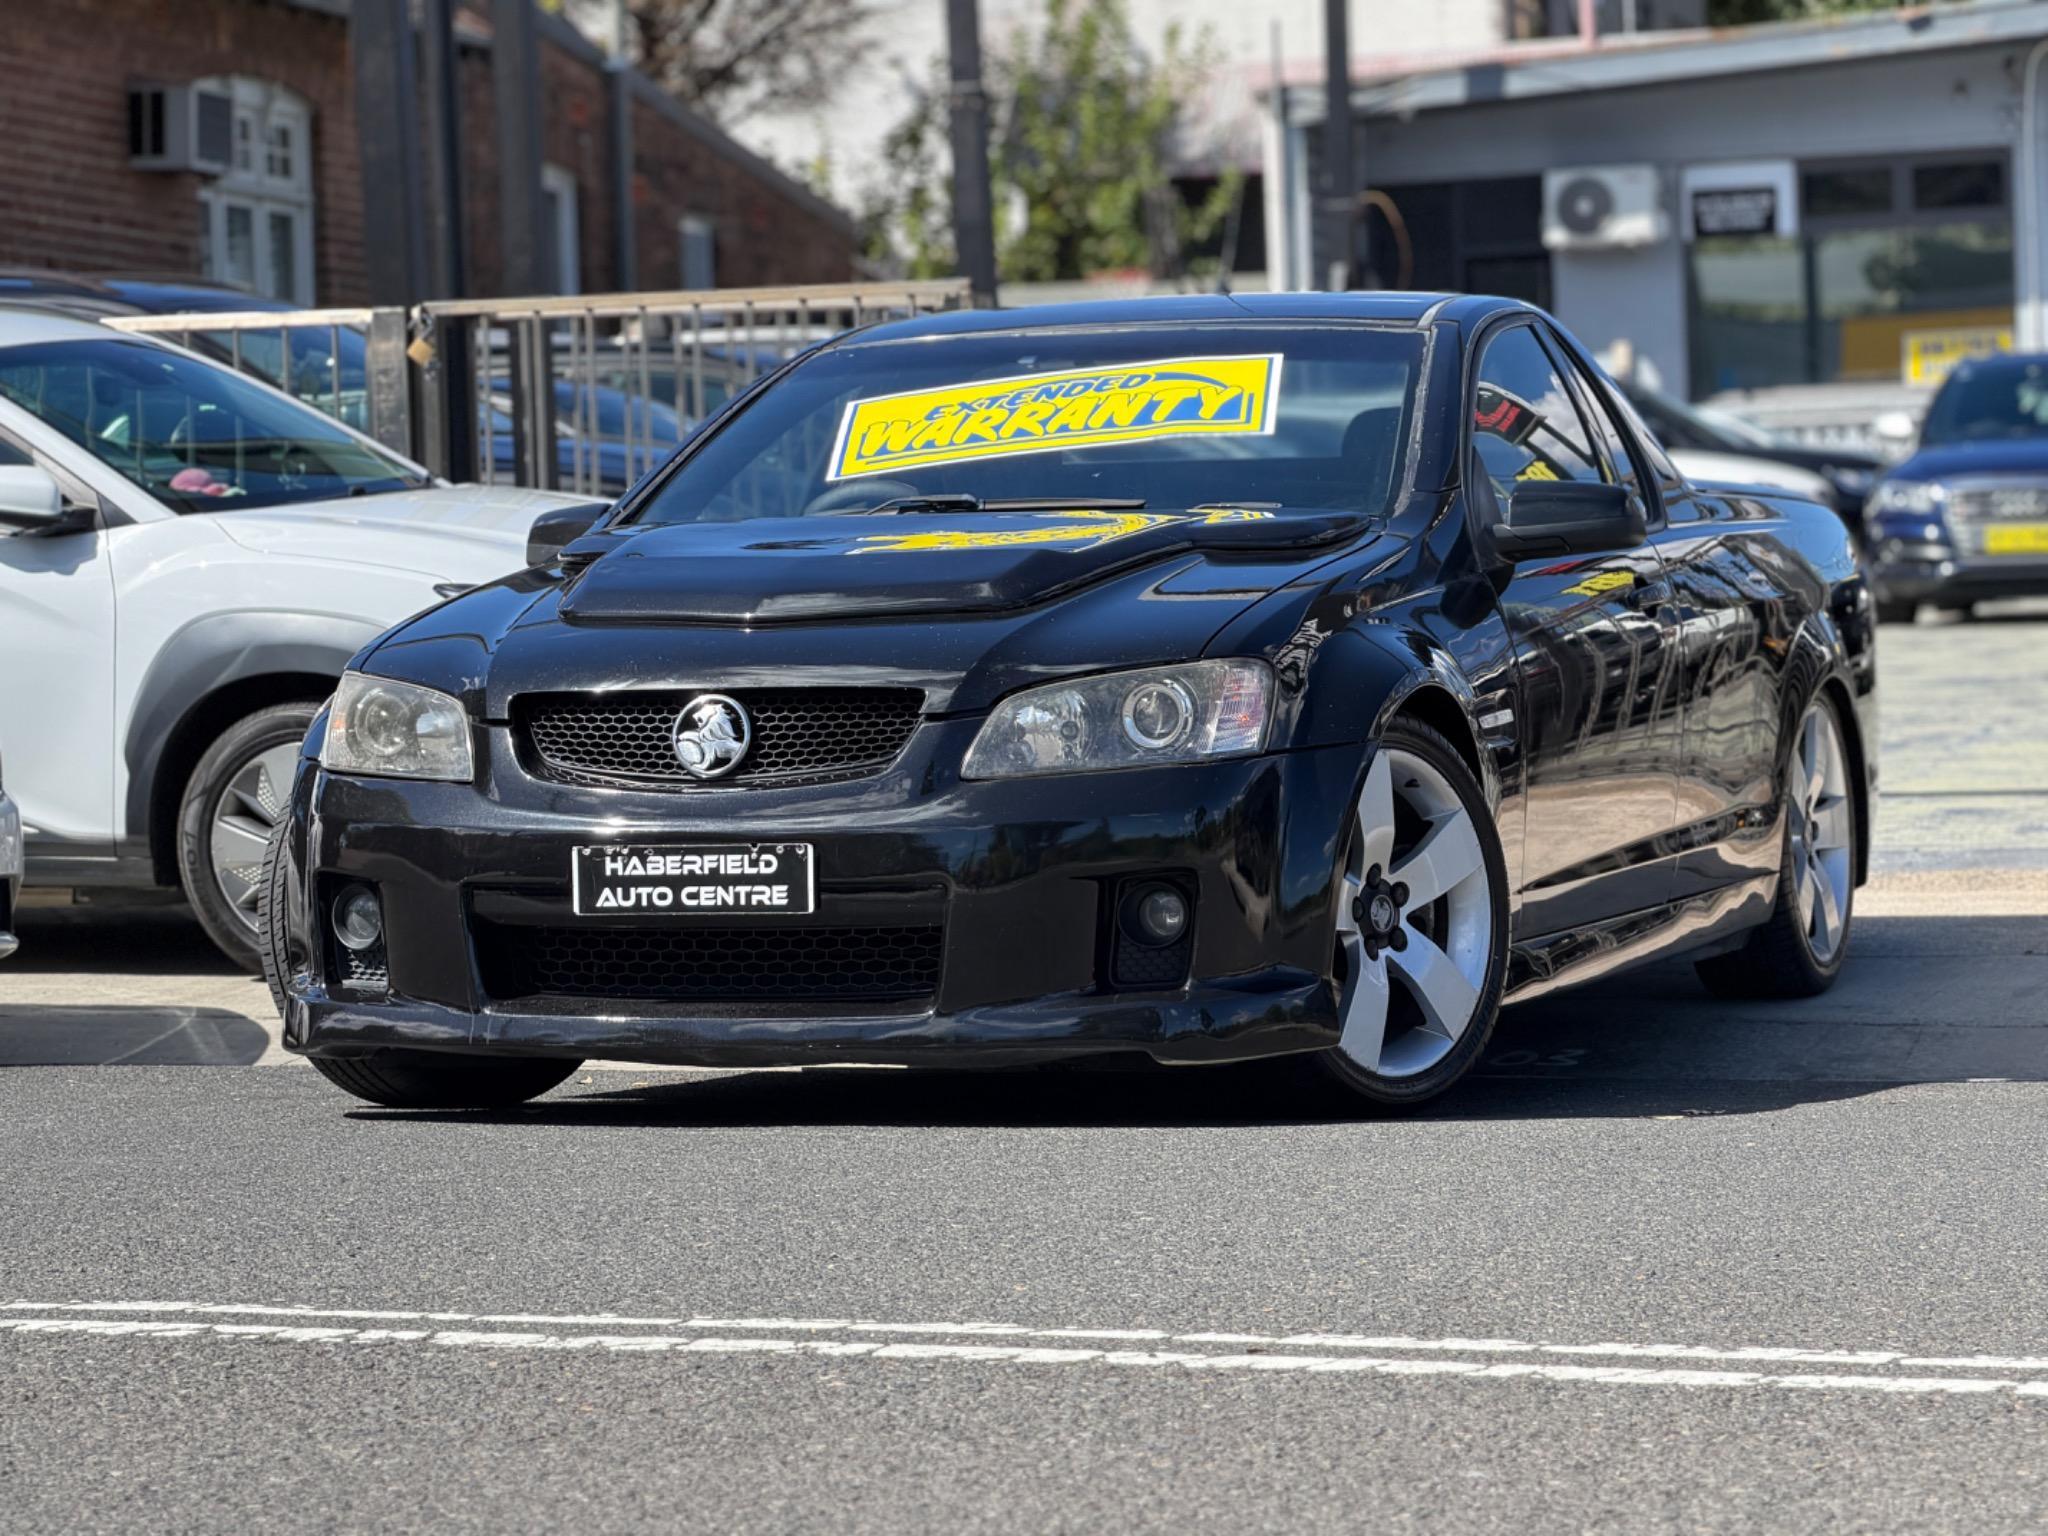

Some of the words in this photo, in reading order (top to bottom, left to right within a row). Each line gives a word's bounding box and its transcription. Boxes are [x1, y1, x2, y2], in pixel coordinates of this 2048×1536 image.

[924, 372, 1155, 422] EXTENDED
[862, 385, 1244, 456] WARRANTY
[605, 854, 778, 876] HABERFIELD
[596, 886, 674, 907] AUTO
[680, 885, 789, 906] CENTRE
